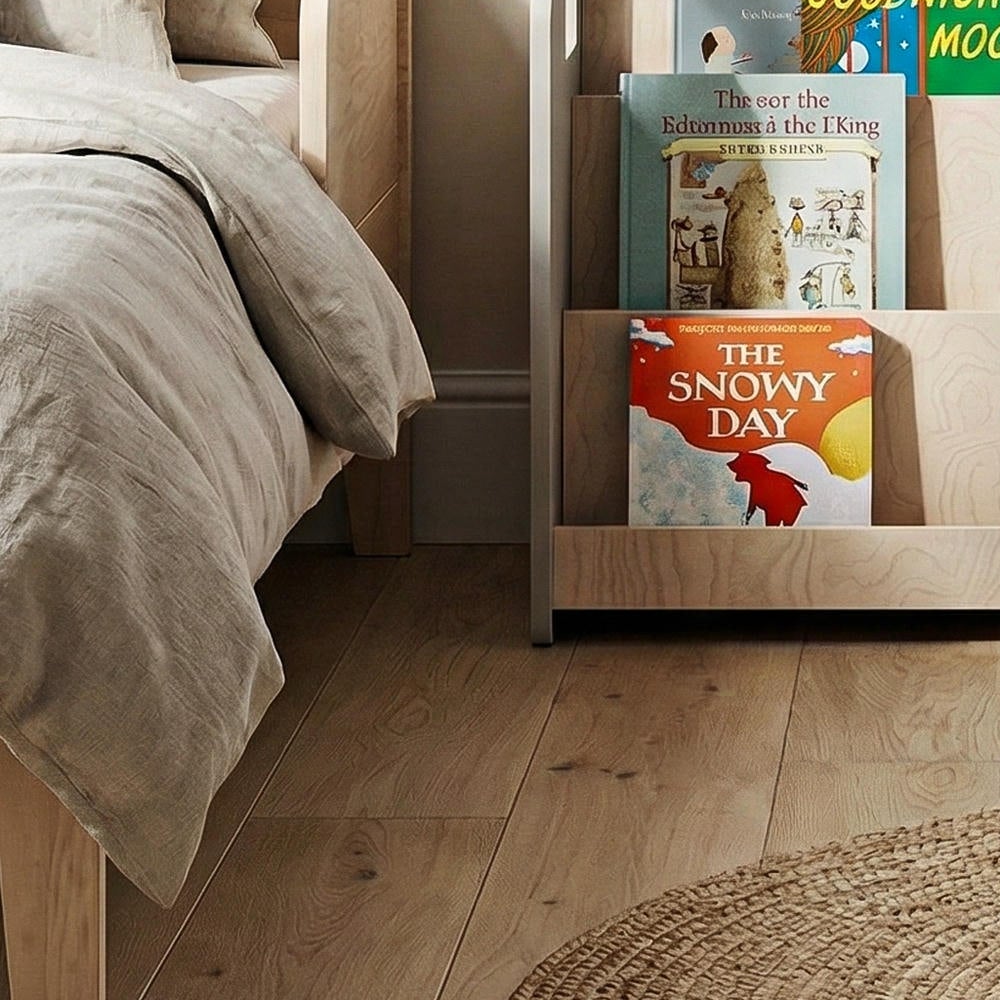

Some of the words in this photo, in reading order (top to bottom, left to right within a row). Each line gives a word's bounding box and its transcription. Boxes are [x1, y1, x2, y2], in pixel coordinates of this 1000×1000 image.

[798, 89, 830, 109] the
[717, 343, 785, 366] THE
[667, 371, 837, 402] SNOWY
[707, 407, 799, 439] DAY
